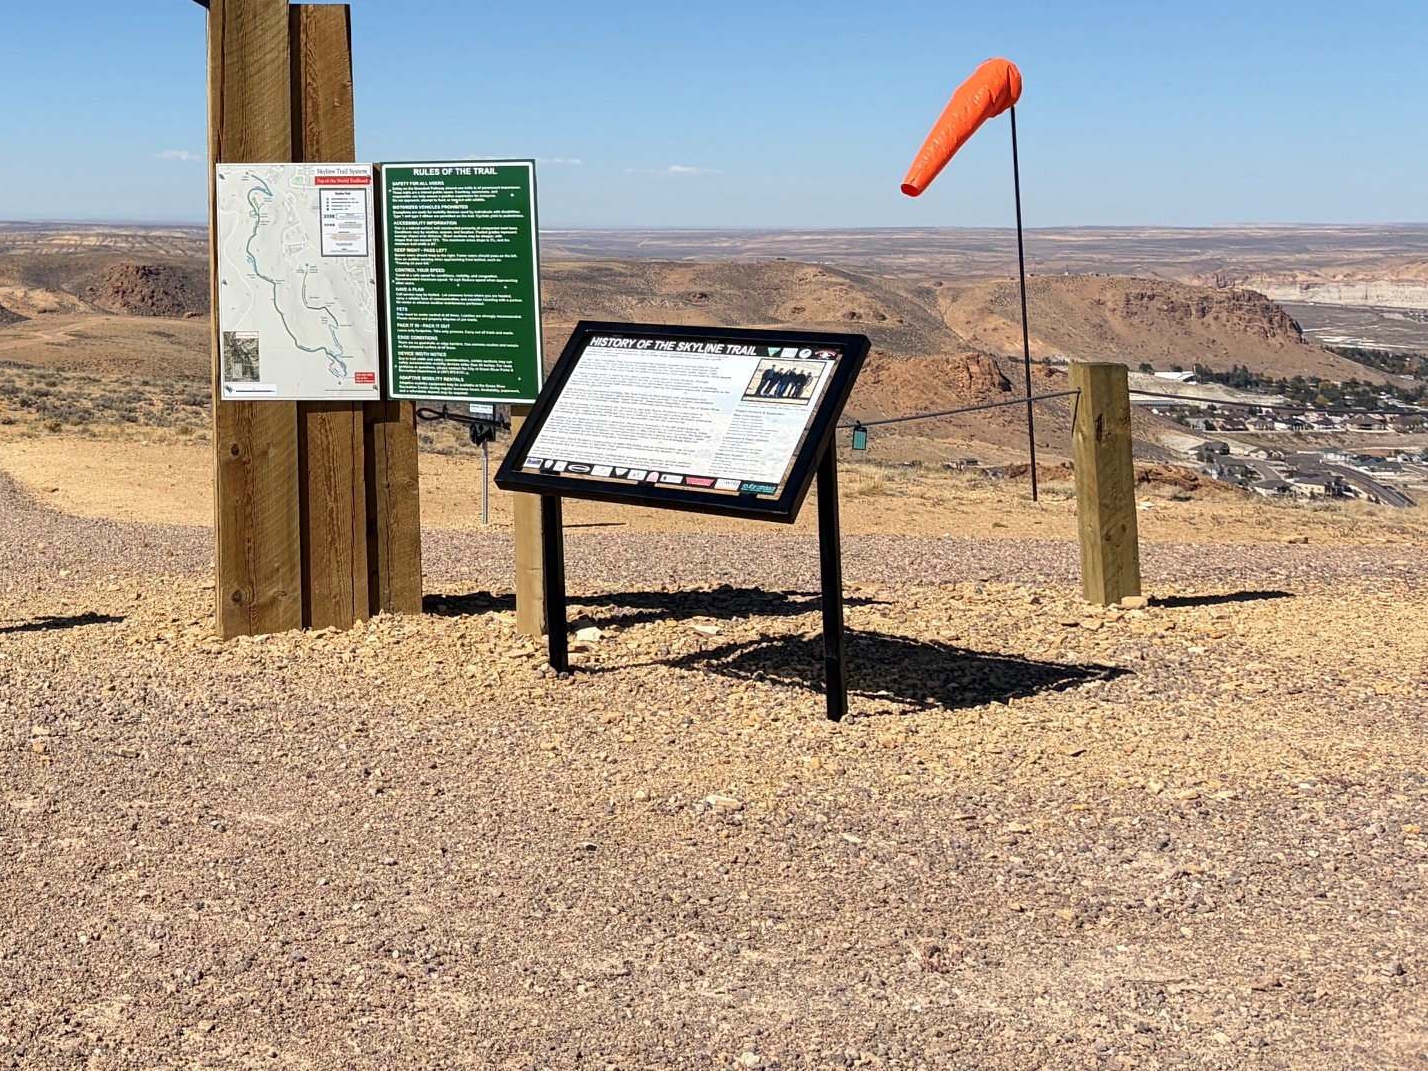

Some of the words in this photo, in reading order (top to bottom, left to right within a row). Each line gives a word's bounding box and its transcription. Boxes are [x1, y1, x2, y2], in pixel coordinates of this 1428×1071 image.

[590, 337, 637, 348] HISTORY
[637, 340, 653, 349] OF
[654, 340, 676, 350] THE
[676, 342, 725, 353] SKYLINE
[726, 345, 757, 355] TRAIL
